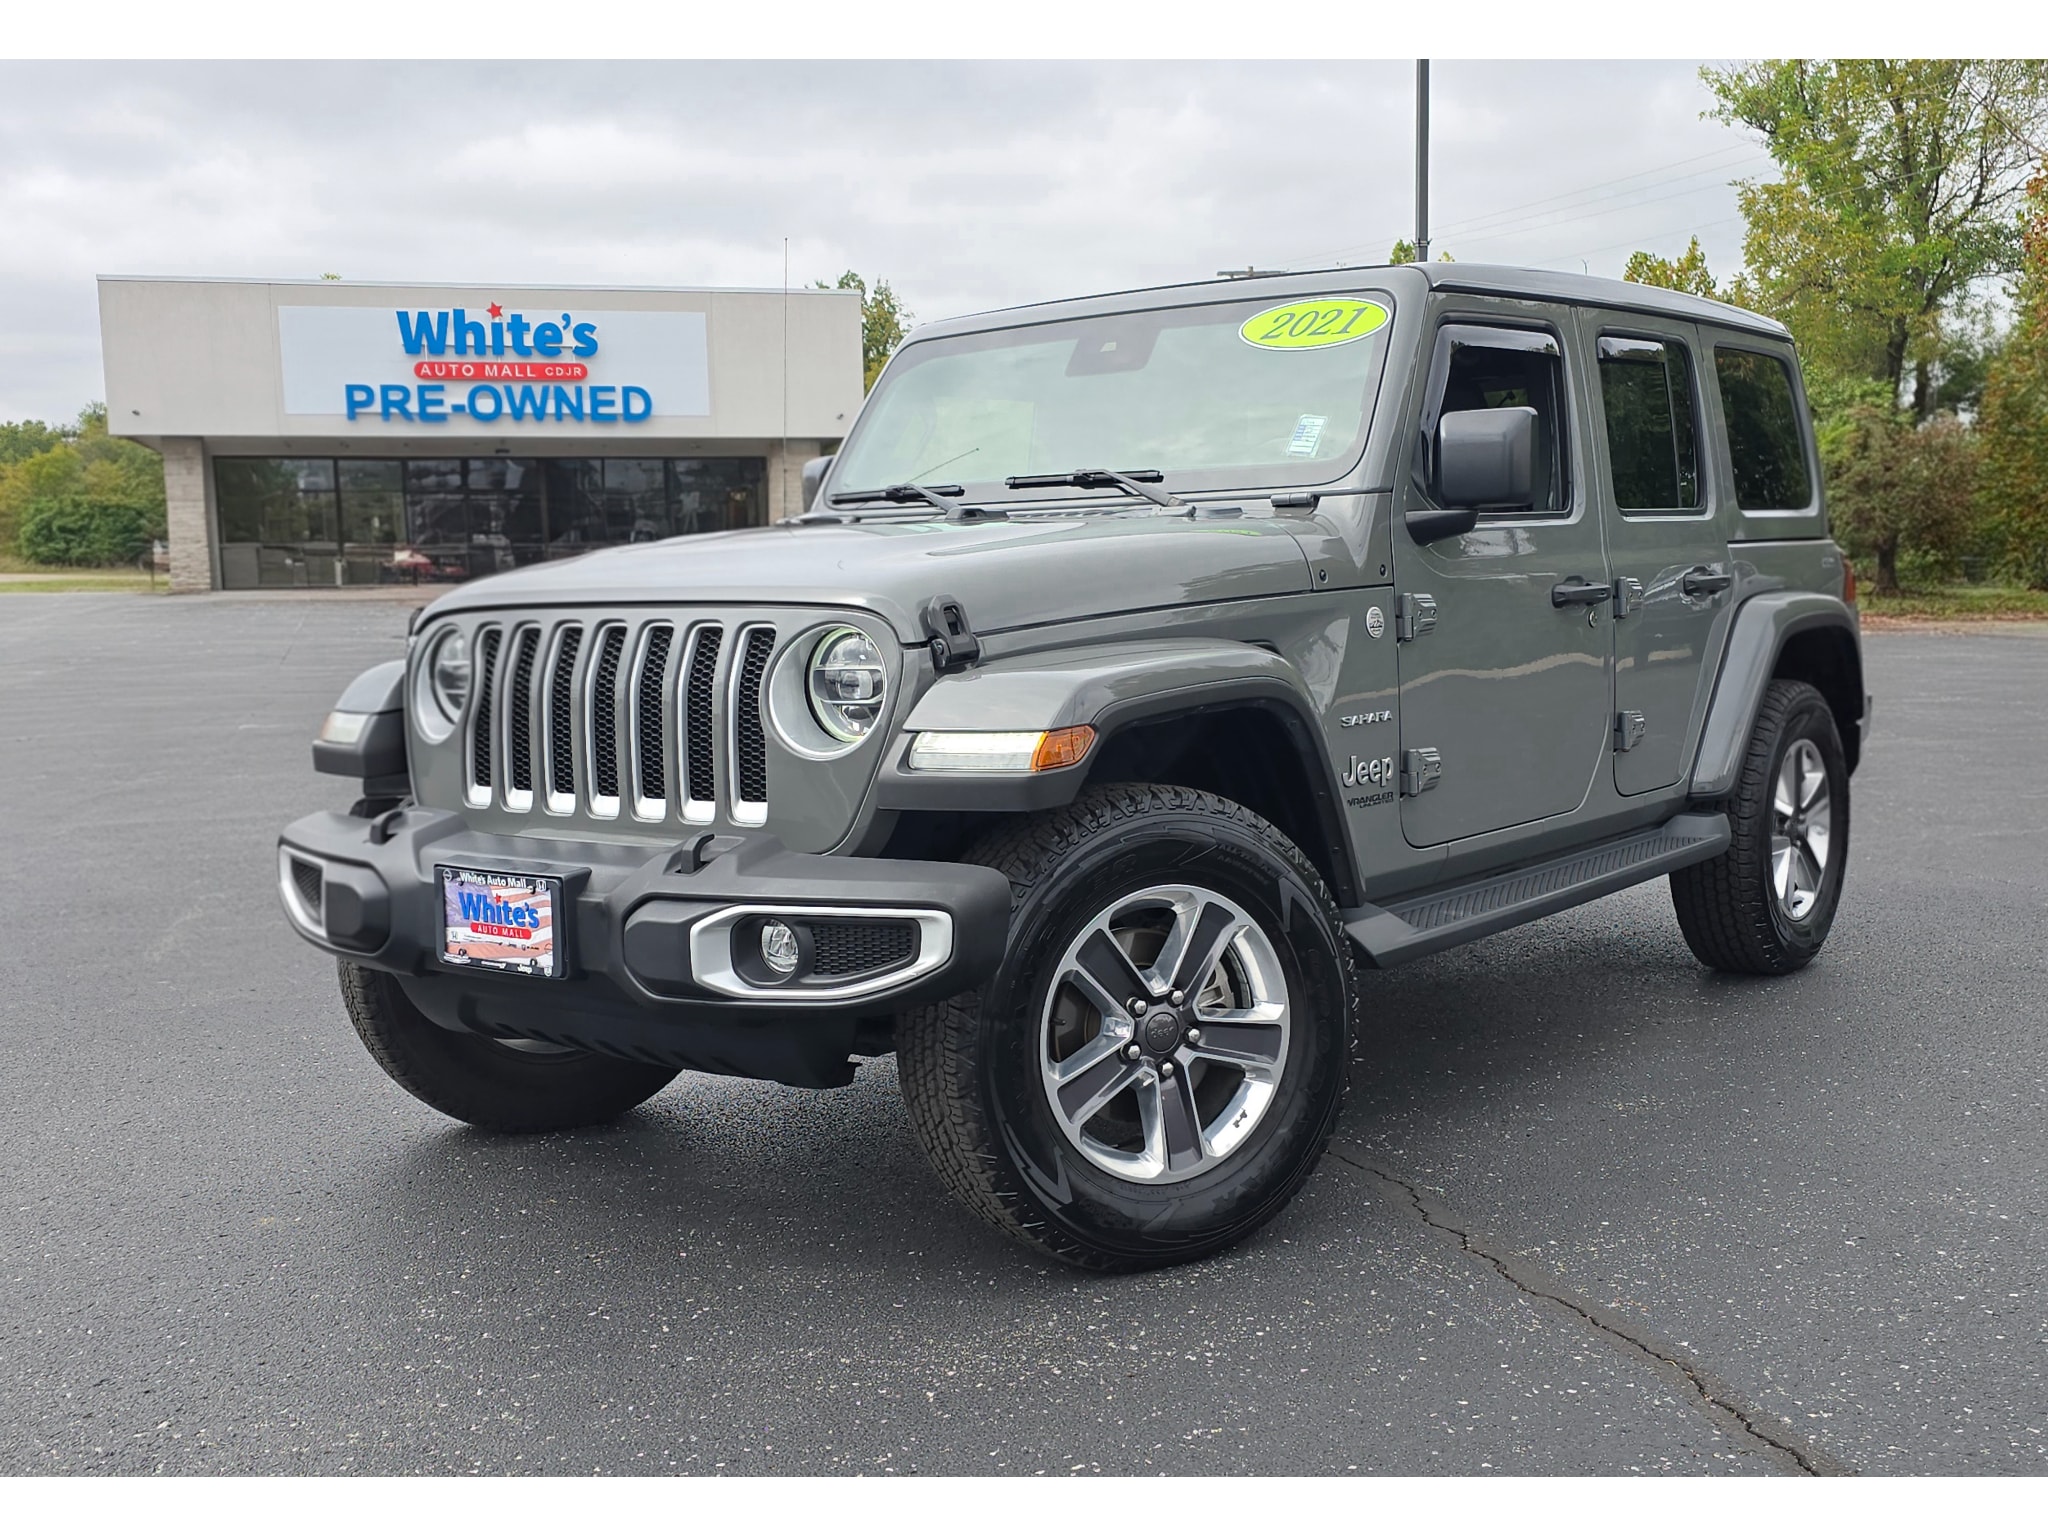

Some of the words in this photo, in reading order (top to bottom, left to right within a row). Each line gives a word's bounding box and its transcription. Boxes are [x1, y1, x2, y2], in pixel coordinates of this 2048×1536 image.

[396, 303, 599, 358] White's
[1260, 306, 1368, 340] 2021
[419, 363, 475, 378] AUTO
[485, 363, 536, 378] MALL
[545, 366, 582, 378] CDJR
[345, 383, 653, 424] PRE-OWNED
[1340, 711, 1392, 727] SAHARA
[1343, 755, 1393, 786] Jeep
[1347, 791, 1394, 807] WRANGLER
[459, 871, 486, 885] White's
[487, 875, 506, 887] Auto
[508, 877, 527, 888] Mall
[458, 892, 540, 929] White's
[477, 924, 498, 935] AUTO
[502, 928, 524, 939] MALL
